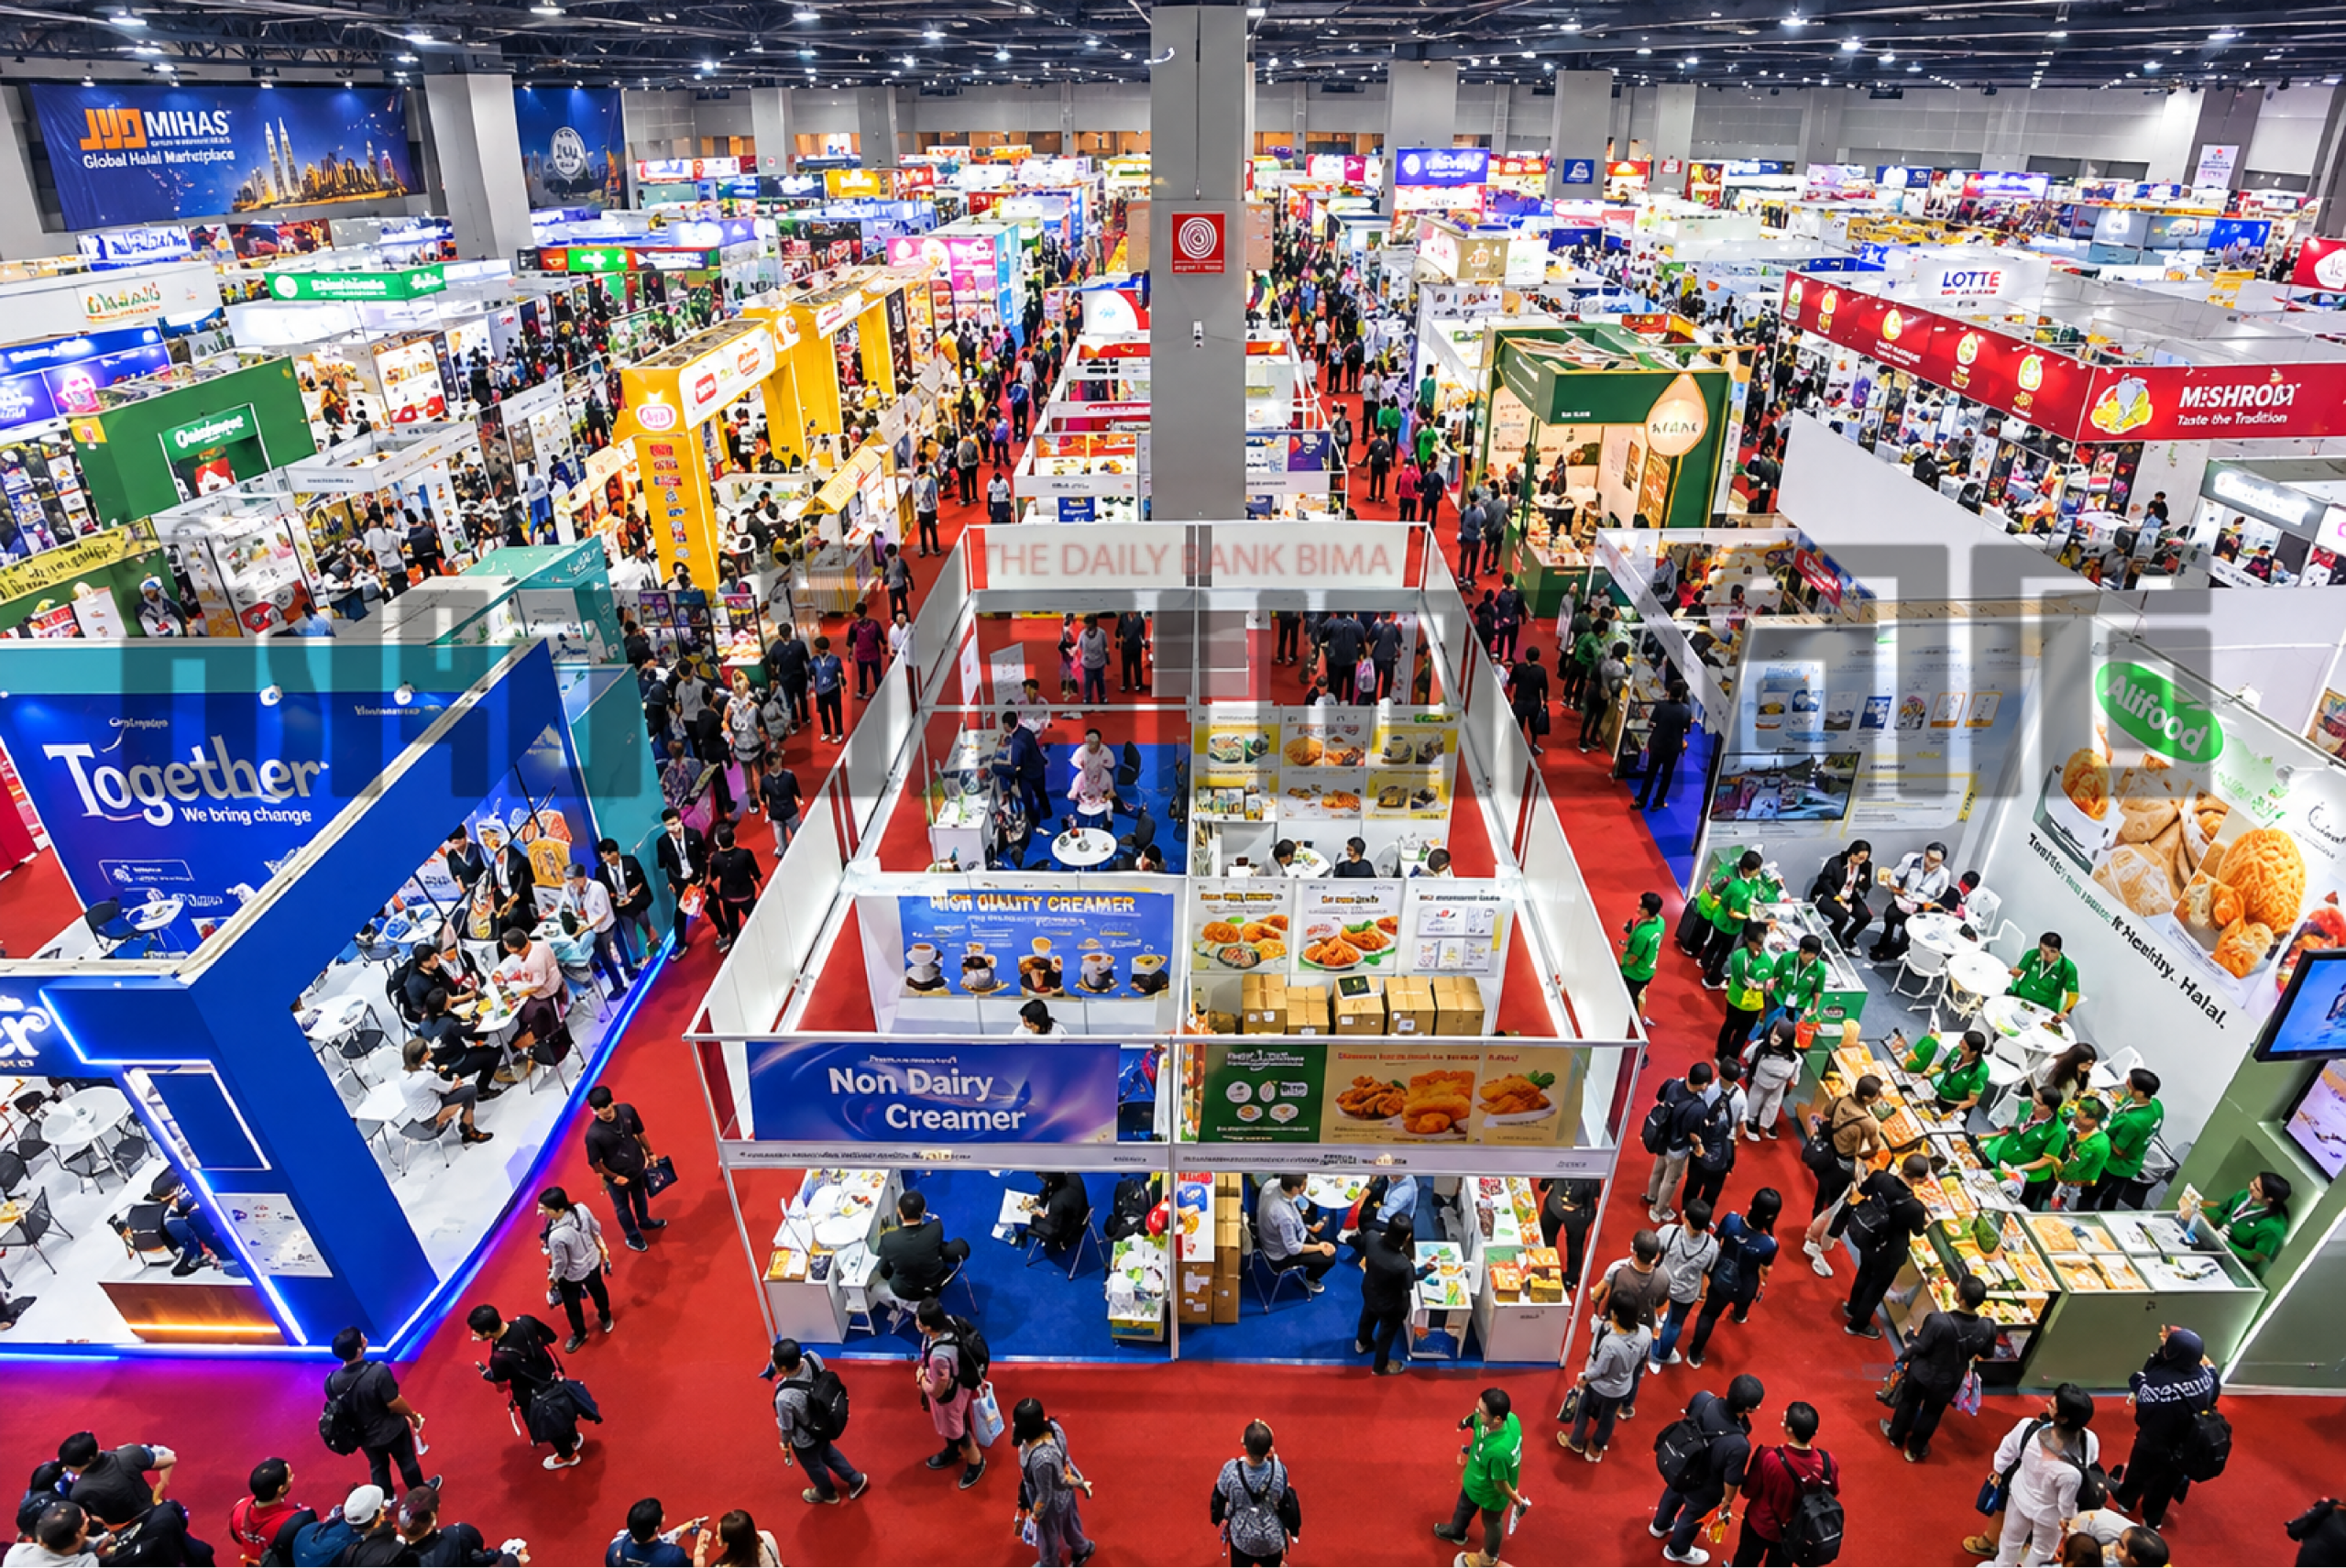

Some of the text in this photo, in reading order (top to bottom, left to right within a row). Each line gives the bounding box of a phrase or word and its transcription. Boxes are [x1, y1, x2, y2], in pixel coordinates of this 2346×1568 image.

[144, 110, 229, 137] MIHAS
[82, 152, 127, 169] Global
[129, 150, 162, 166] Halal
[1942, 270, 2001, 288] LOTTE
[2210, 413, 2232, 425] the
[2103, 674, 2209, 757] Alifood
[42, 734, 320, 827] Together
[181, 806, 312, 825] We bring change
[1047, 894, 1135, 913] CREAMER
[2179, 977, 2227, 1029] Halal.
[828, 1067, 994, 1102] Non Dairy
[884, 1102, 1027, 1131] Creamer
